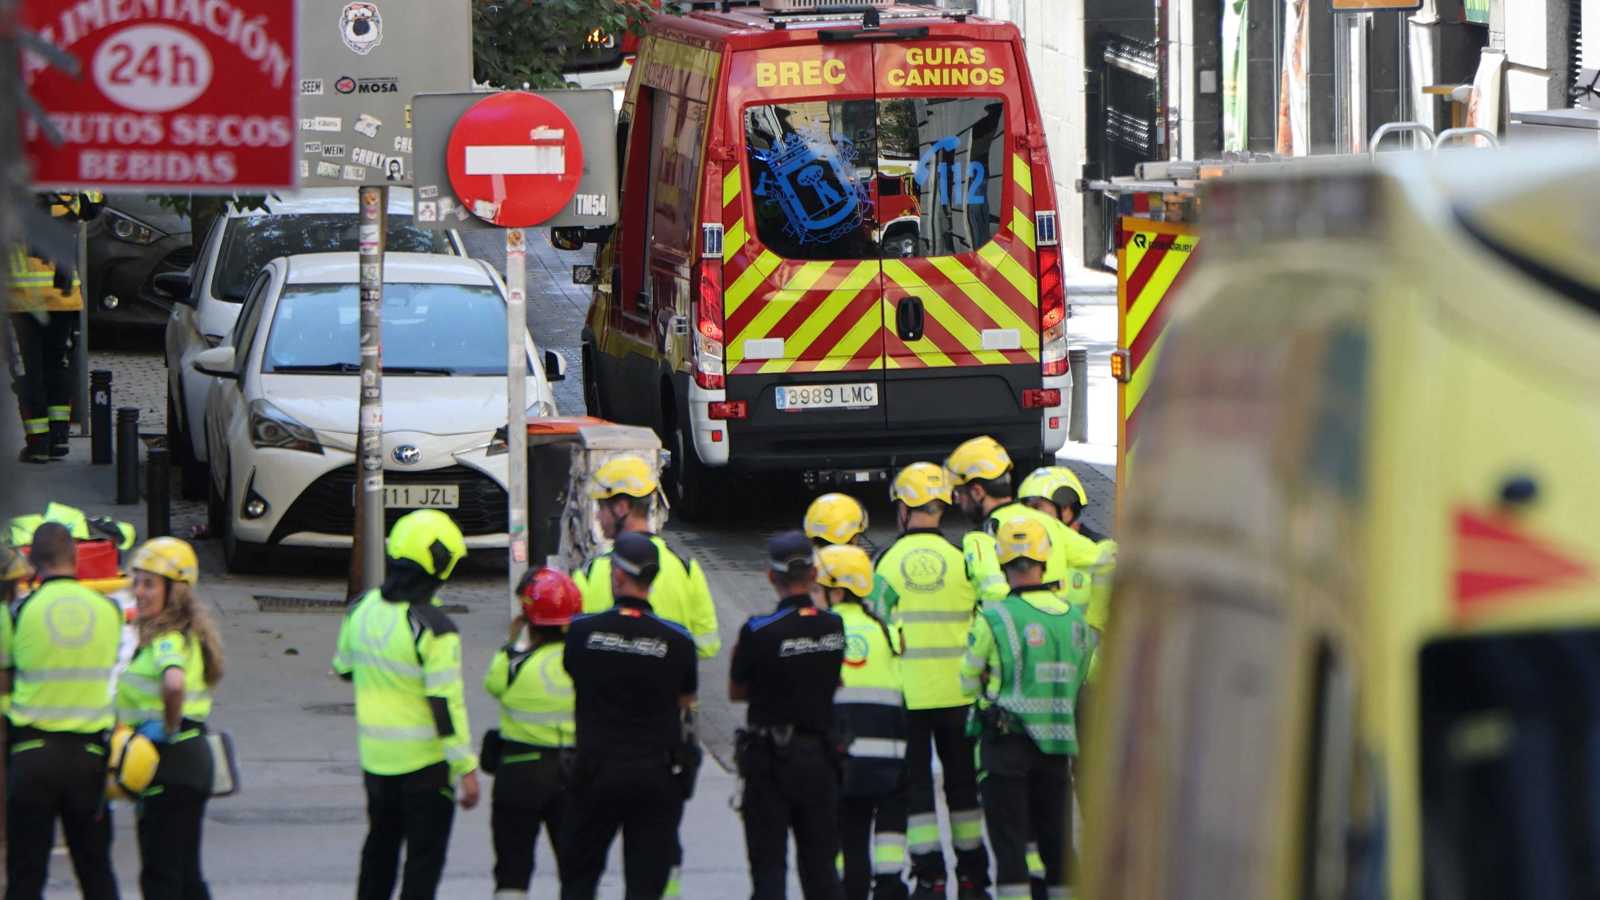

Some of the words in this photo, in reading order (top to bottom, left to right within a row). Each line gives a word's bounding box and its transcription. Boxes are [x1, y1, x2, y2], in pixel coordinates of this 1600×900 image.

[107, 44, 197, 86] 24h
[906, 47, 986, 65] GUIAS
[756, 59, 846, 88] BREC
[888, 68, 1005, 86] CANINOS
[359, 83, 398, 93] MOSA
[171, 115, 290, 147] SECOS
[79, 152, 237, 182] BEBIDAS
[936, 161, 986, 204] 112
[576, 195, 607, 216] TM54
[789, 388, 833, 405] 3989
[840, 386, 873, 403] LMC
[419, 488, 452, 505] JZL
